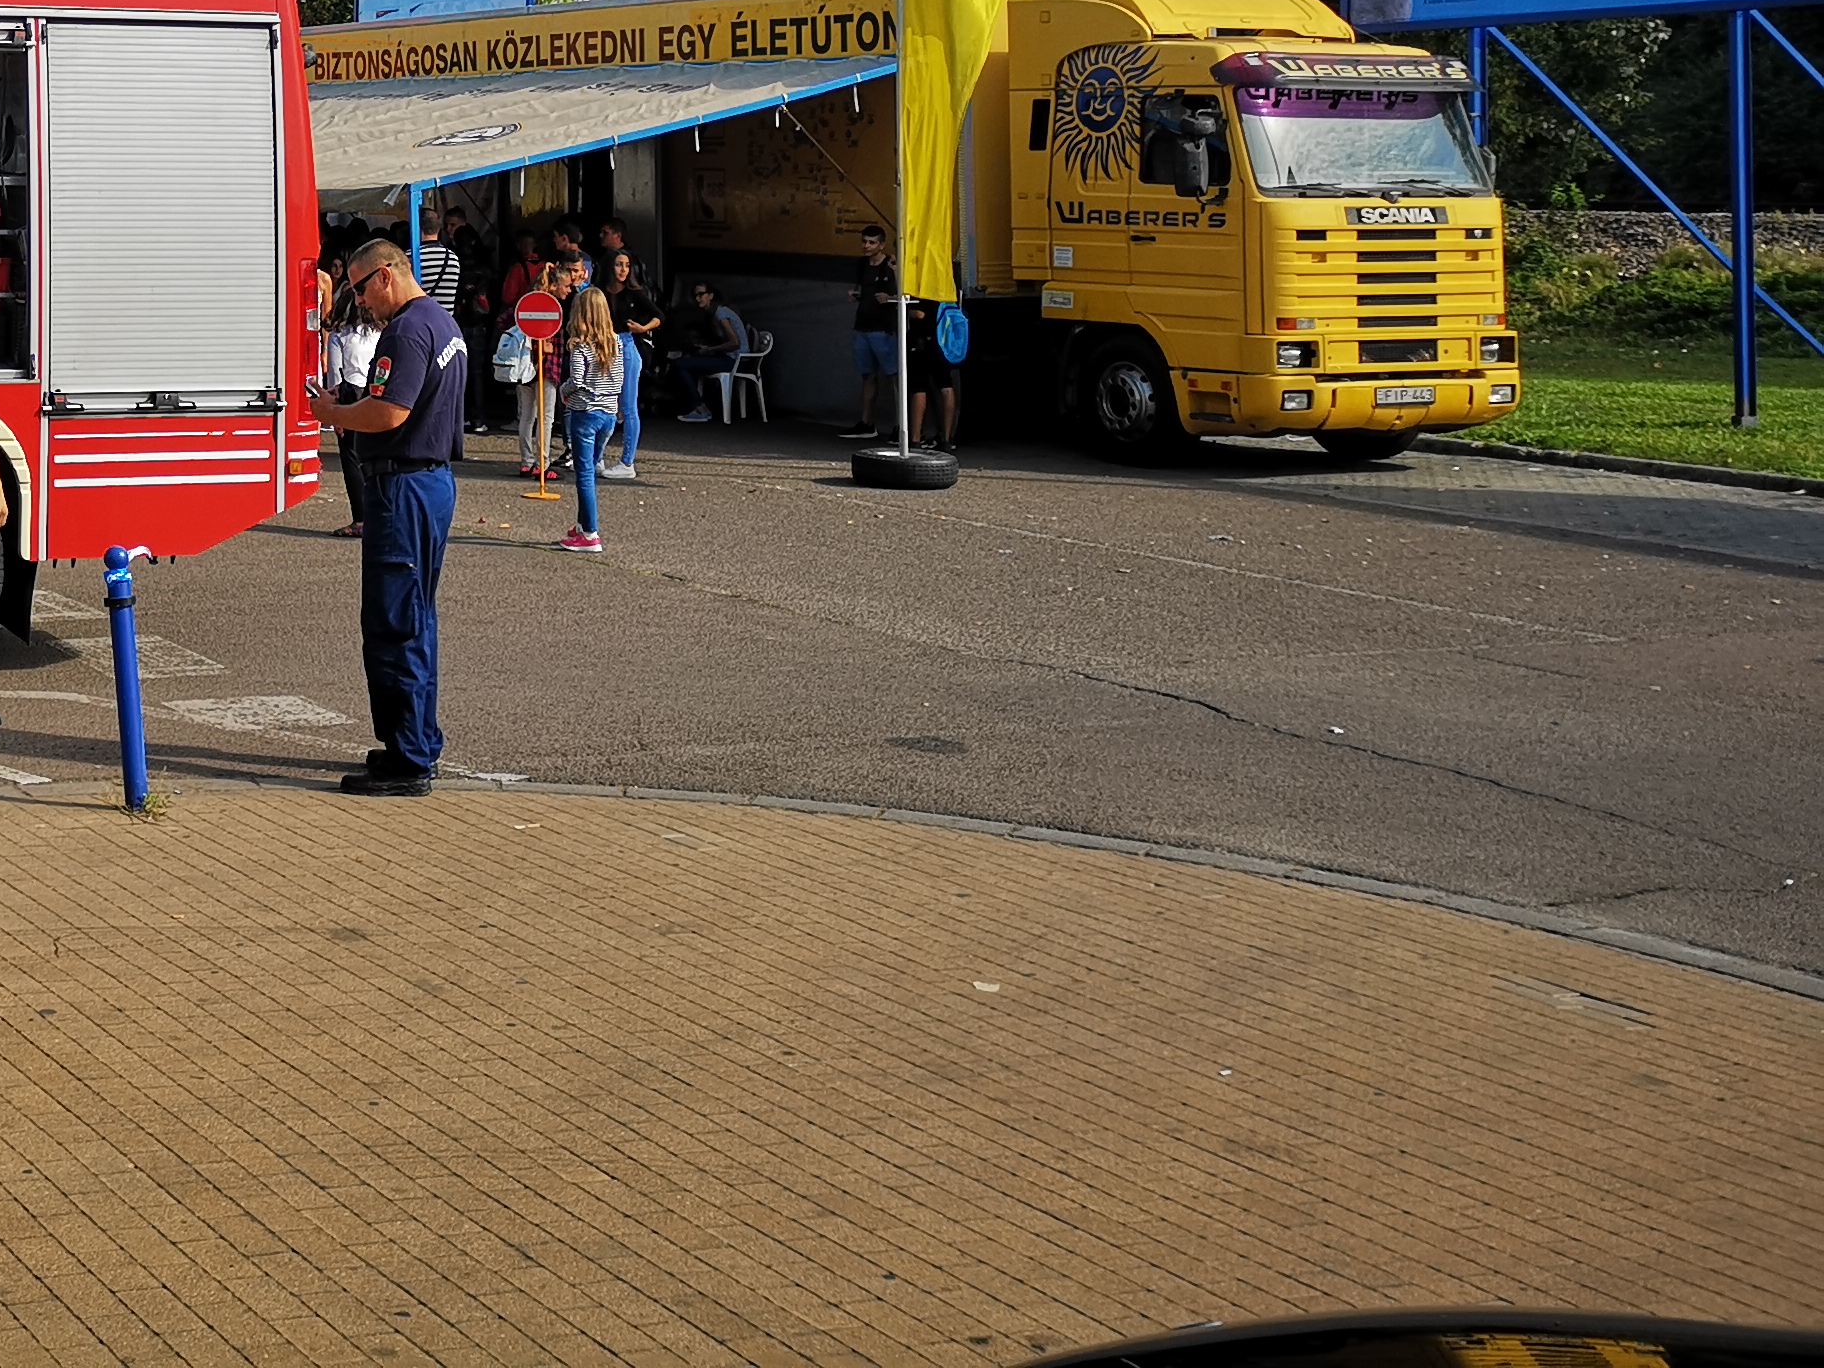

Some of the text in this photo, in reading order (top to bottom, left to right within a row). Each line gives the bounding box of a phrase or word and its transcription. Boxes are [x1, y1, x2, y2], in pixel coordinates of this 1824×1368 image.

[314, 40, 477, 81] BIZTONSÁGOSAN
[486, 28, 646, 71] KÖZLEKEDNI
[657, 22, 717, 62] EGY
[1267, 58, 1468, 79] WABERER'S
[1054, 201, 1227, 229] WABERER'S
[1360, 207, 1436, 224] SCANIA
[1384, 388, 1434, 401] FIP-443
